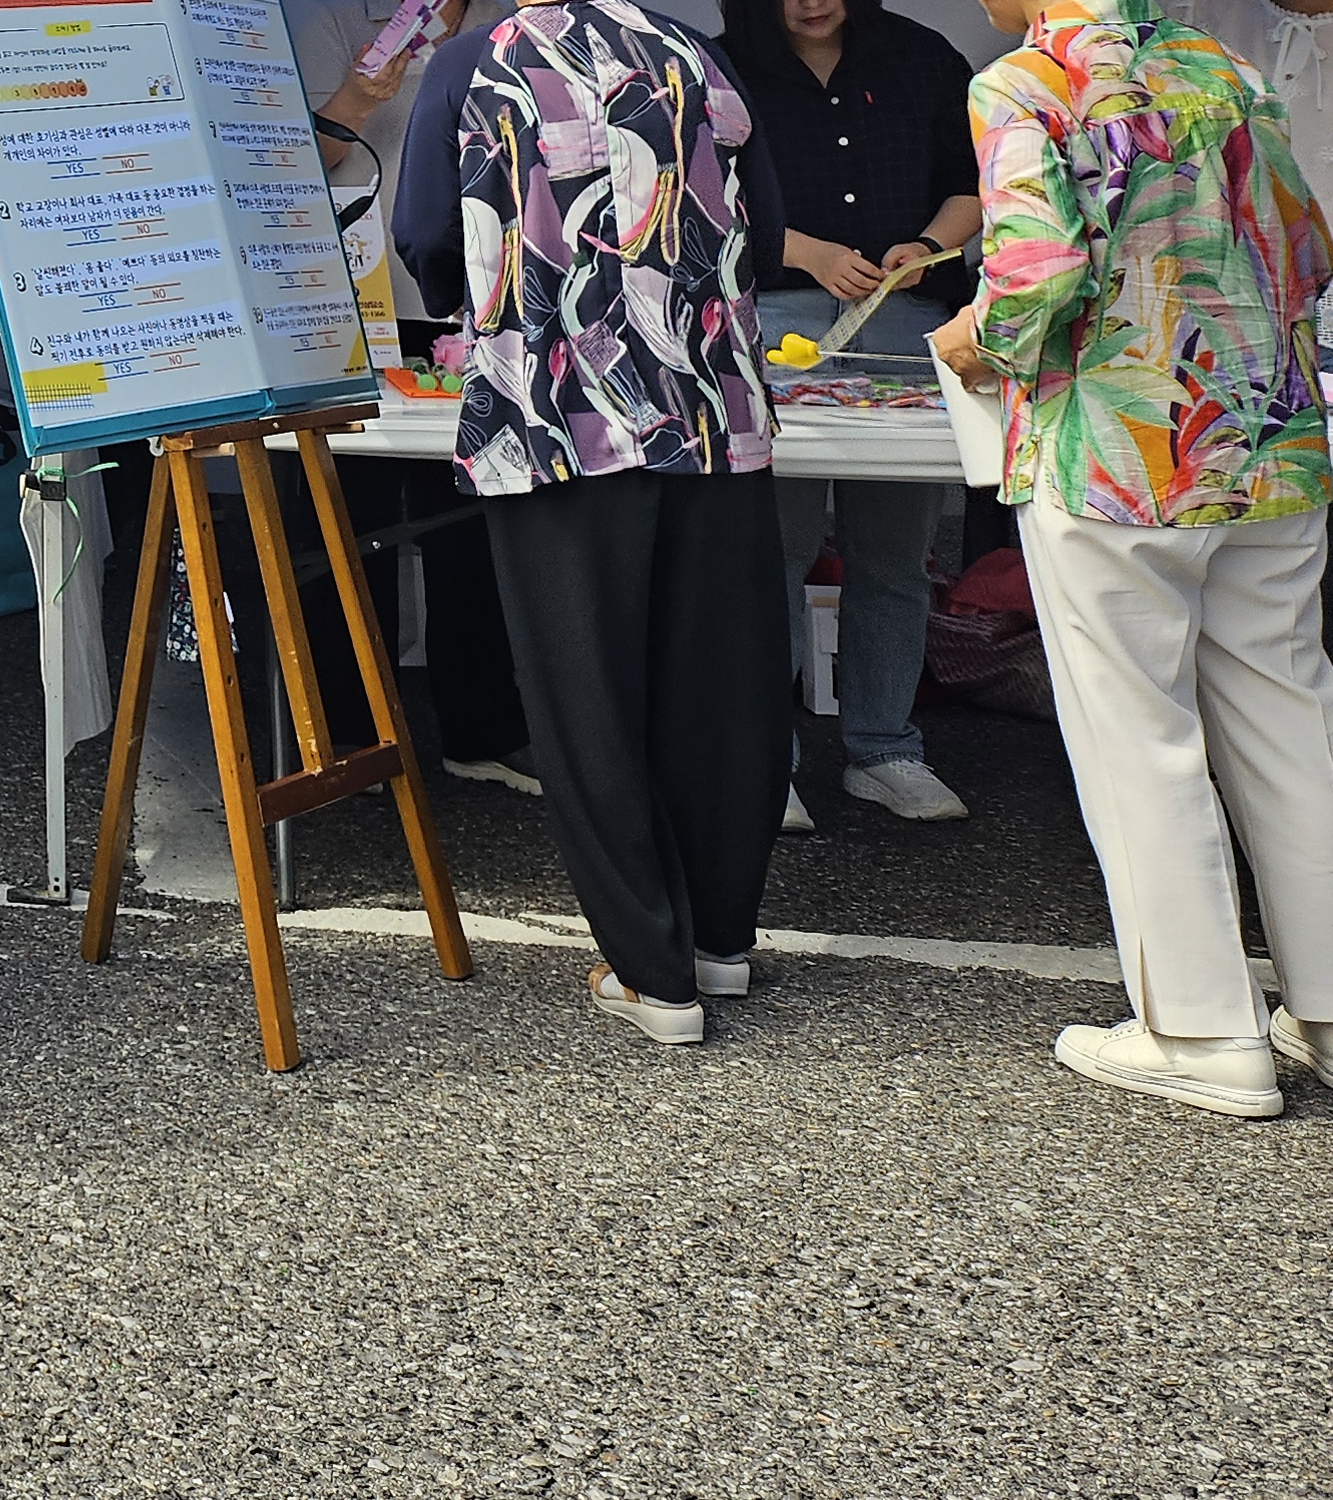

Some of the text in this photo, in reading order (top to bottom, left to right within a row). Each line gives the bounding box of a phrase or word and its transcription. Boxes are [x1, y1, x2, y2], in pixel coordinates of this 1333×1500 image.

[69, 127, 93, 141] 관심은
[136, 123, 151, 135] 다른
[169, 120, 190, 132] 아니라
[65, 158, 134, 174] YES NO
[82, 224, 150, 241] YES NO
[13, 271, 26, 292] 3
[98, 289, 166, 307] YES NO
[47, 332, 72, 347] 친구와
[74, 330, 91, 343] 내가
[112, 324, 135, 337] 나오는
[138, 319, 167, 334] 사진이나
[30, 336, 44, 355] 4
[121, 341, 139, 354] 받고
[114, 355, 182, 374] YES NO
